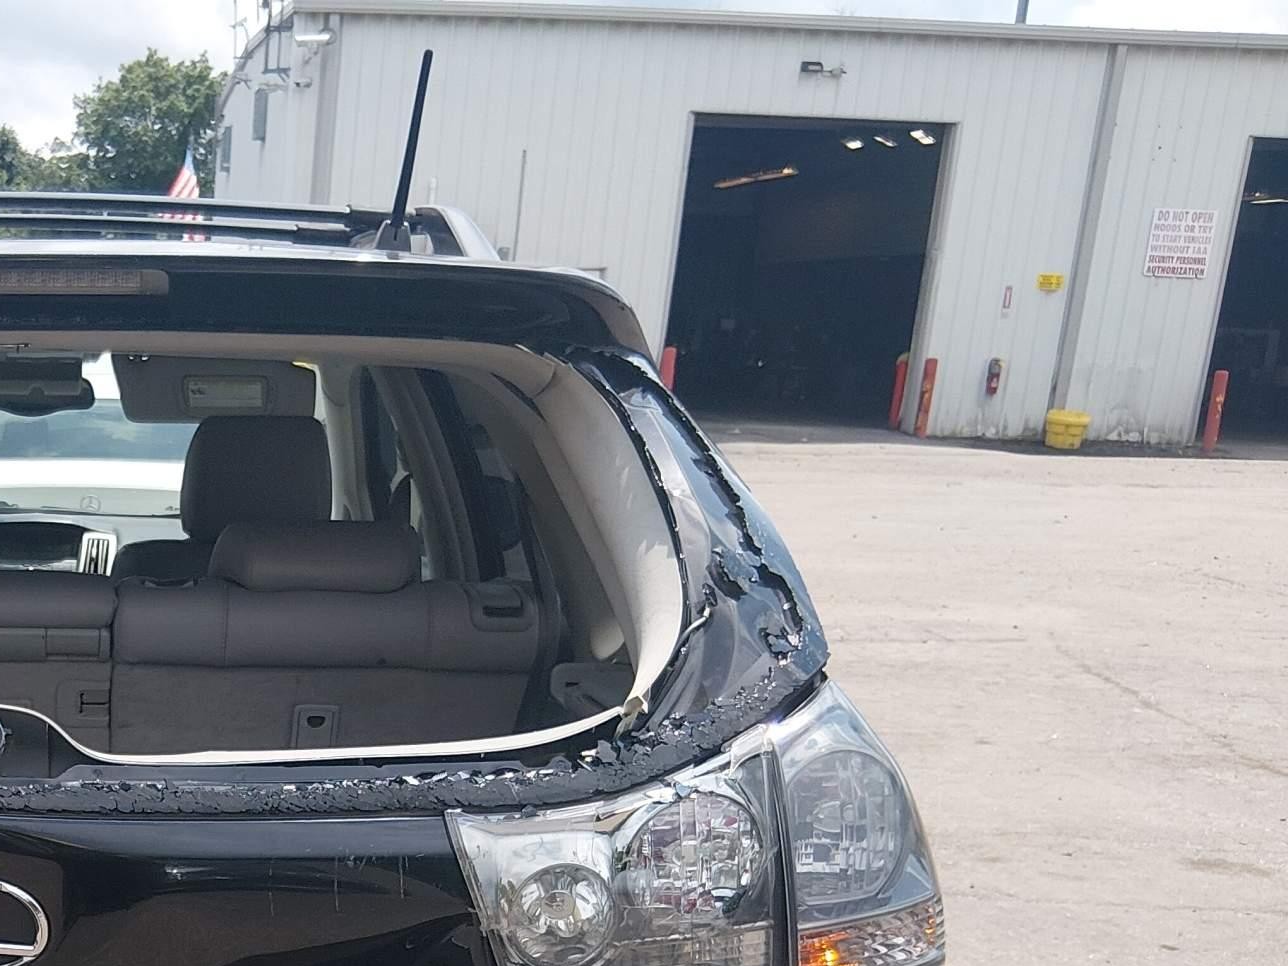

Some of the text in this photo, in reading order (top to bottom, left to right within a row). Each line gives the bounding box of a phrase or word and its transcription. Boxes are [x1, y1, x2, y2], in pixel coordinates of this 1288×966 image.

[1158, 210, 1215, 224] DO NOT OPEN
[1153, 223, 1214, 235] HOODS OR TRY
[1151, 233, 1212, 246] TO START VEHICLES
[1150, 244, 1208, 256] WITHOUT IAA
[1148, 254, 1207, 267] SECURITY PERSONNEL
[1145, 265, 1205, 277] AUTHORIZATION
